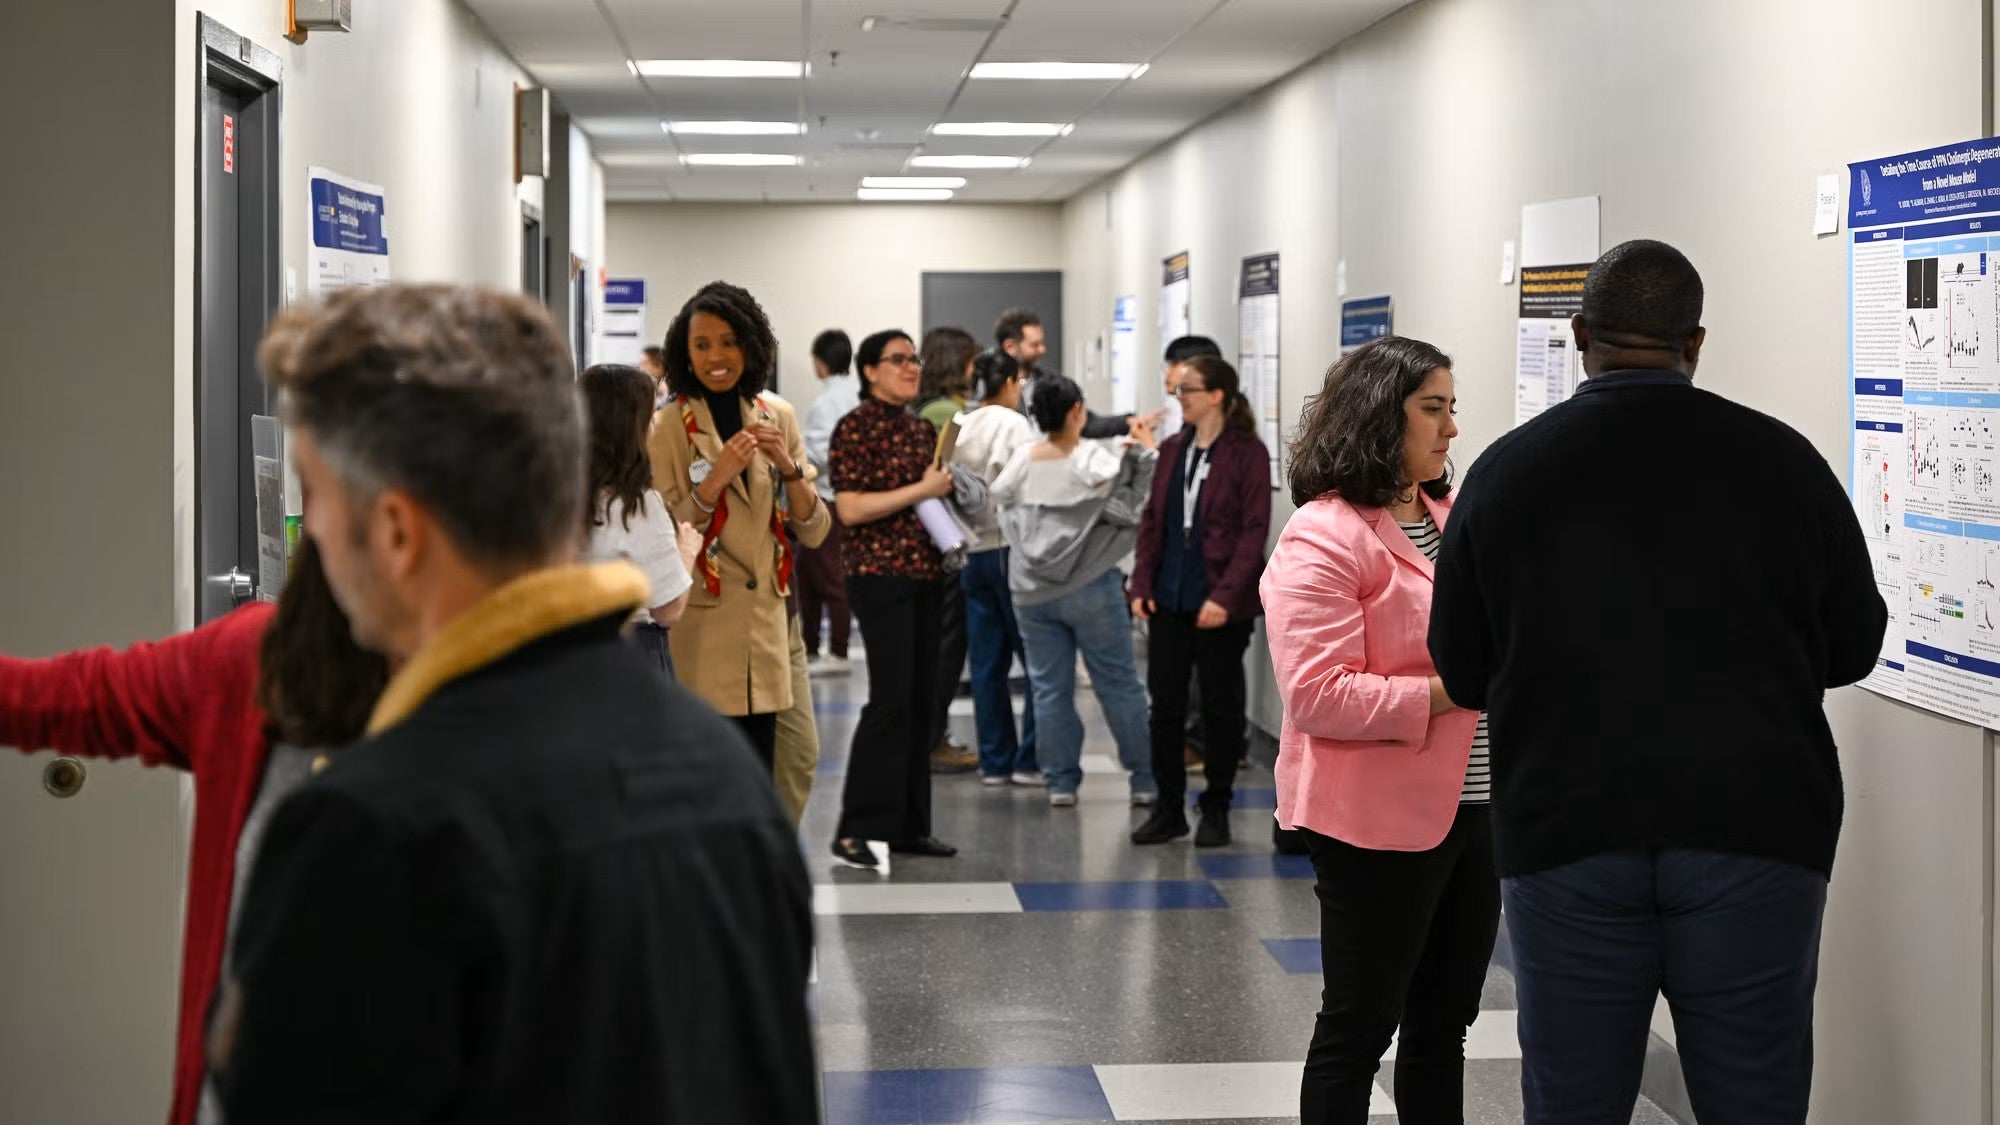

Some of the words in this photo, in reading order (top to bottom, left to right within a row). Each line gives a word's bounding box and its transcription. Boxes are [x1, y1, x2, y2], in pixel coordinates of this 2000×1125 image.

[1880, 163, 1900, 177] Detailing
[1898, 162, 1906, 174] the
[1905, 160, 1917, 172] Time
[1916, 159, 1932, 171] Course
[1932, 155, 1937, 168] of
[1936, 154, 1947, 167] PPN
[1947, 149, 1971, 165] Cholinergic
[1922, 178, 1933, 190] from
[1937, 174, 1949, 188] Novel
[1949, 174, 1962, 187] Mouse
[1963, 169, 1977, 185] Model
